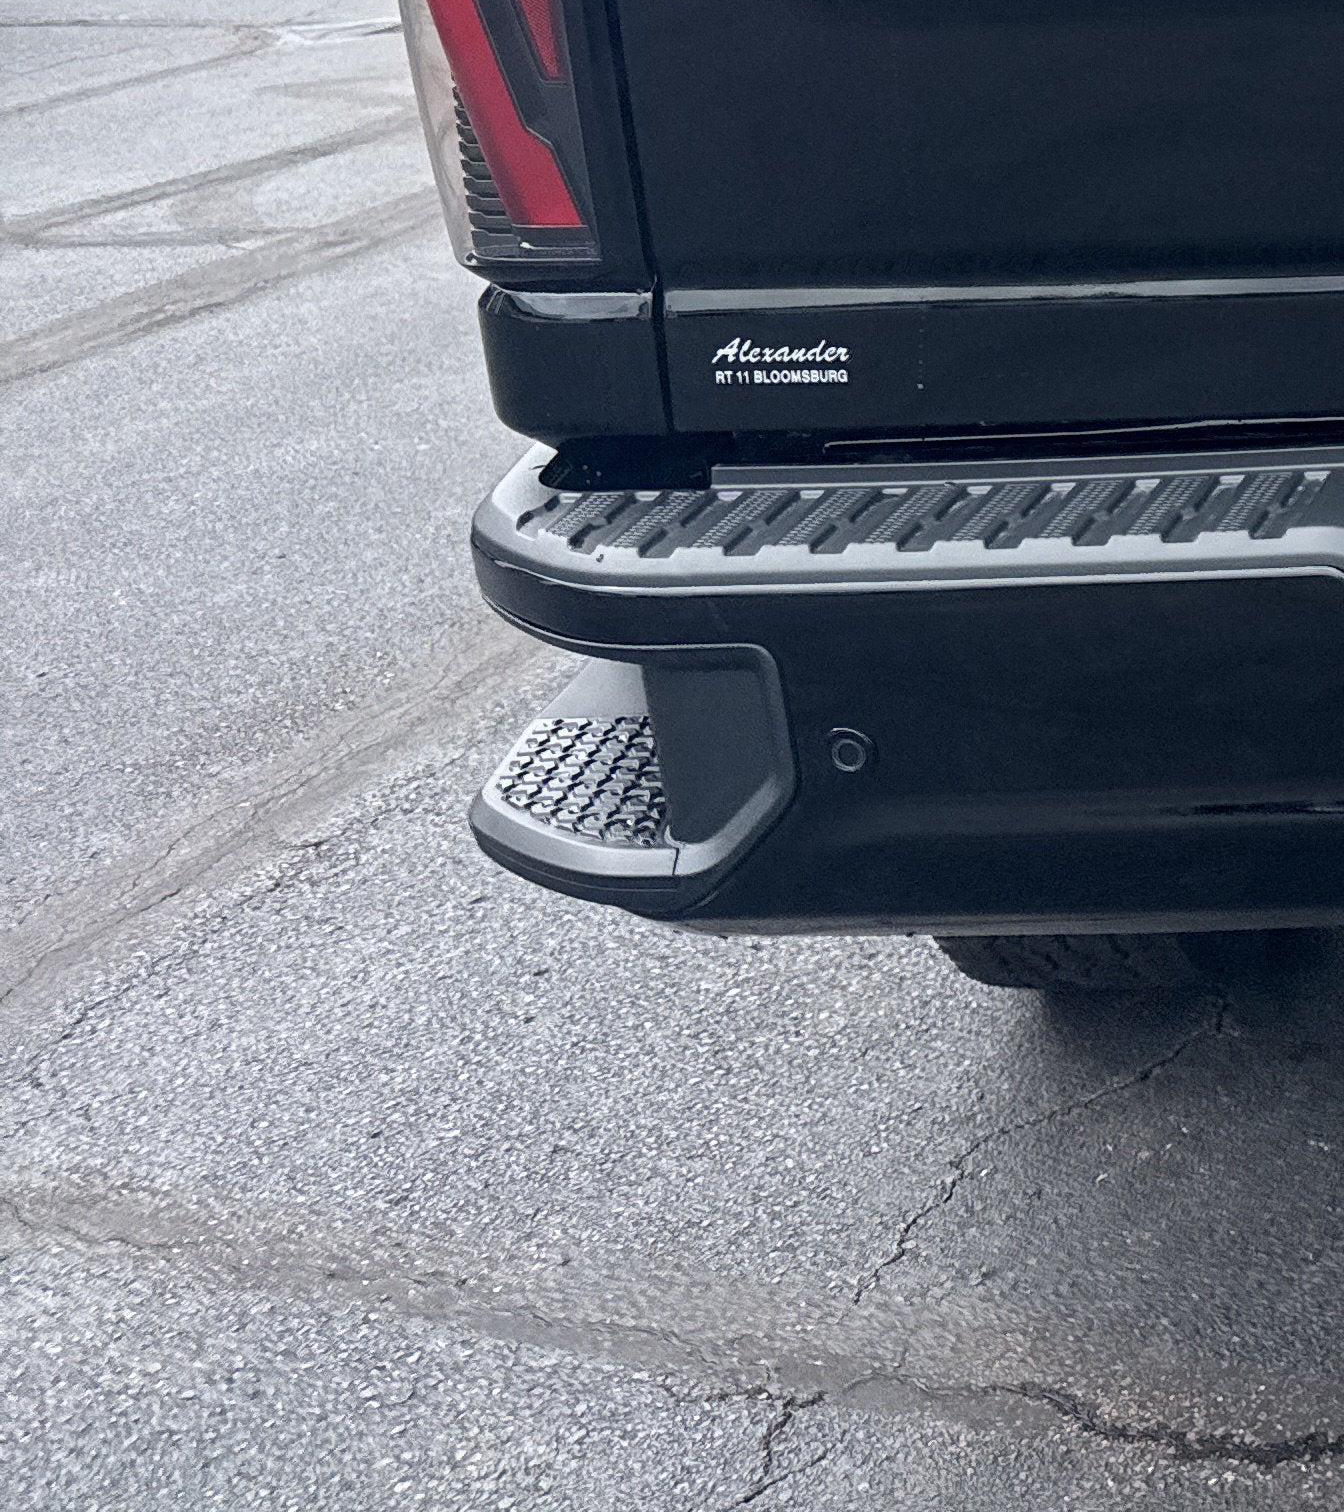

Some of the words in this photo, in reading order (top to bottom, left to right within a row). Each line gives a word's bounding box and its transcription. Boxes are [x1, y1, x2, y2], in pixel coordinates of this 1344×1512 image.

[711, 337, 851, 364] Alexander
[715, 370, 733, 384] RT
[736, 370, 751, 384] 11
[753, 369, 849, 384] BLOOMSBURG
